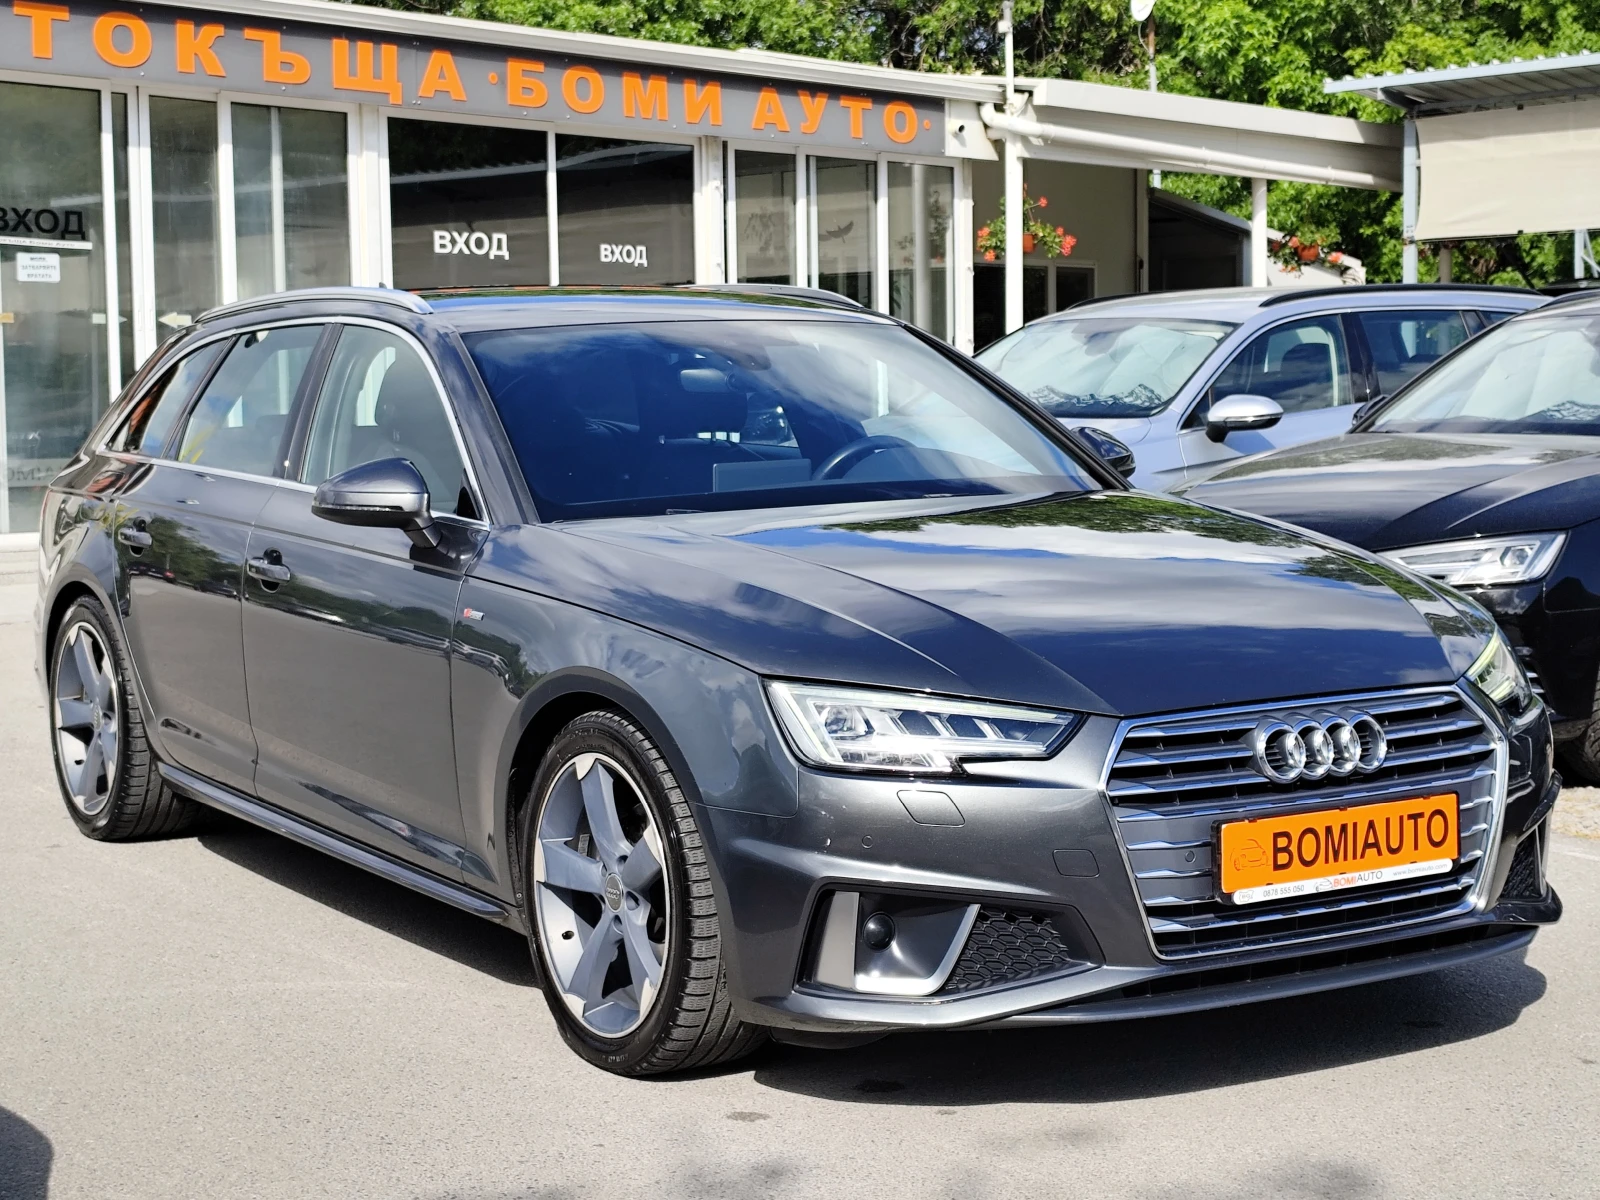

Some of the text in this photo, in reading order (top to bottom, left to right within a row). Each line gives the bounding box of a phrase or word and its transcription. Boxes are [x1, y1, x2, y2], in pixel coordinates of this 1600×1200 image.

[13, 1, 919, 144] ТОКЪЩА БОМИ АУТО
[433, 230, 510, 261] ВХОД
[600, 243, 648, 267] ВХОД
[1272, 808, 1449, 872] BOMIAUTO
[1393, 863, 1448, 876] www.bomiauto.com
[1263, 884, 1305, 897] 0878 555 050
